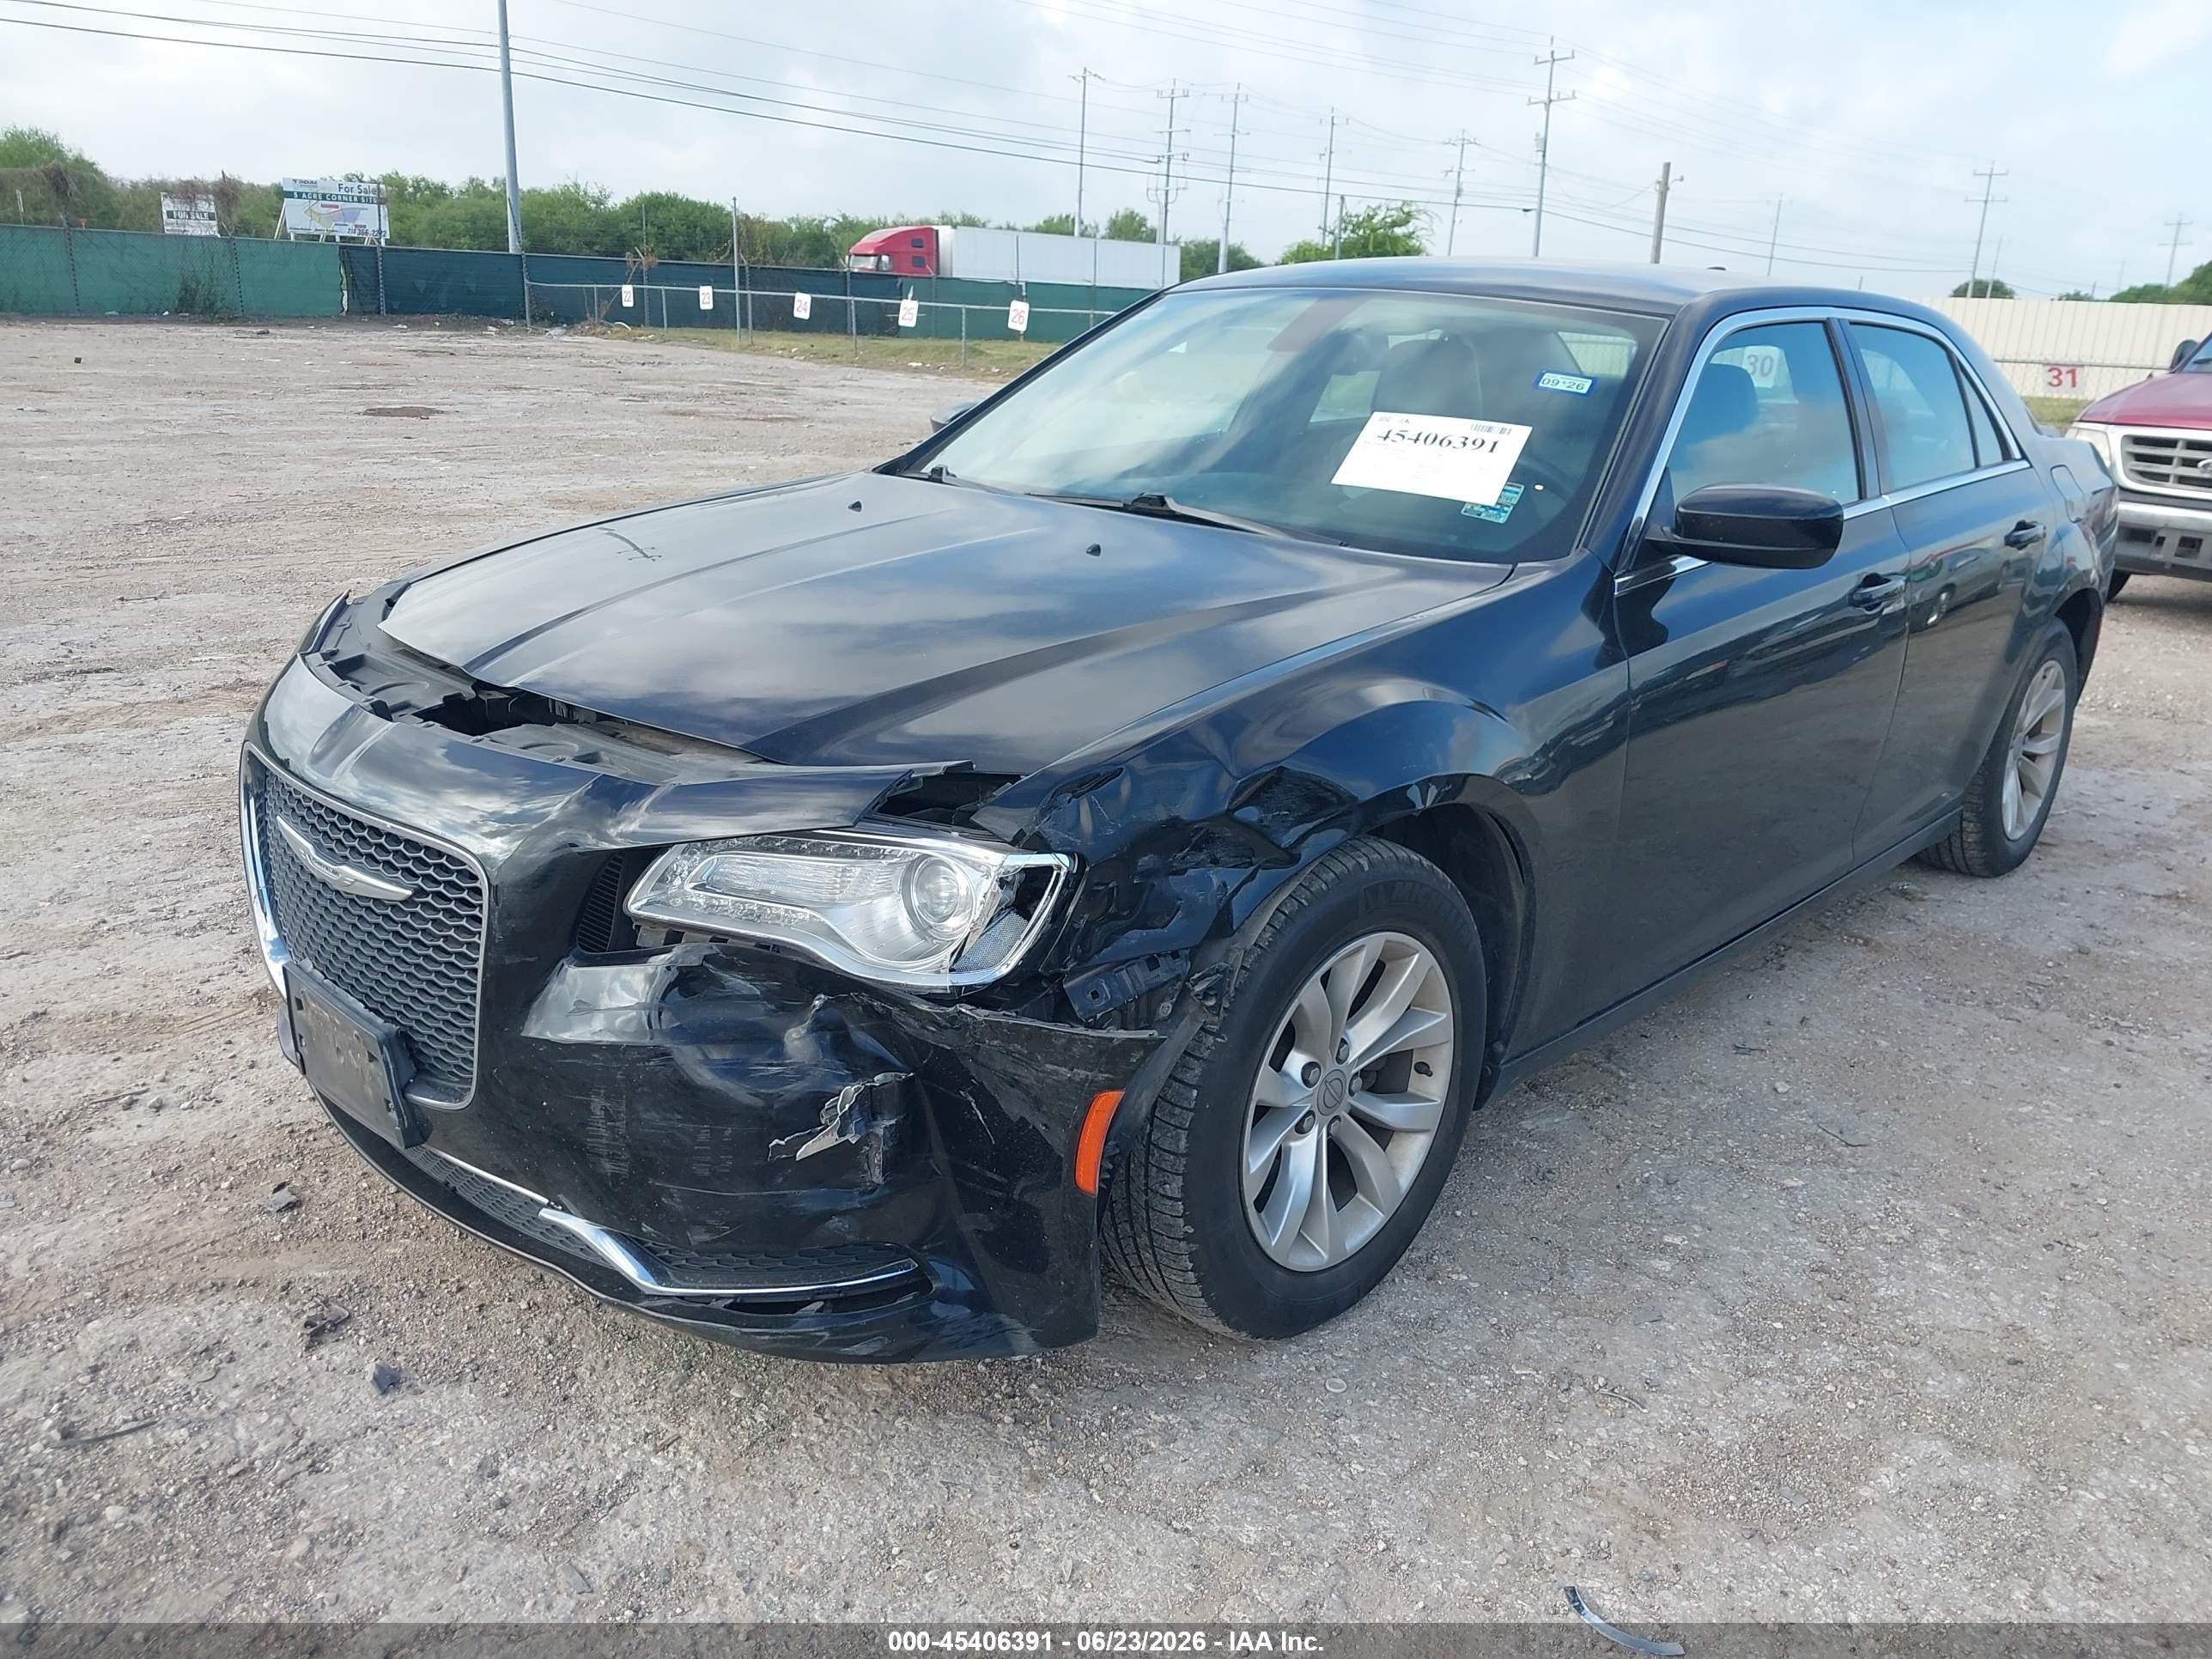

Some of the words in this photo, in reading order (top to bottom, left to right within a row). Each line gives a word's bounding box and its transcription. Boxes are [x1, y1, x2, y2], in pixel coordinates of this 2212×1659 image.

[337, 183, 355, 193] For
[356, 184, 378, 196] Sale
[190, 211, 210, 221] SALE
[623, 290, 632, 302] 22
[701, 292, 711, 305] 23
[796, 299, 808, 313] 24
[902, 307, 915, 322] 25
[1011, 308, 1025, 325] 26
[1746, 354, 1774, 378] 30
[1541, 377, 1560, 386] 09
[1565, 380, 1585, 391] 26
[2046, 367, 2079, 388] 31
[1376, 428, 1500, 454] 45406391
